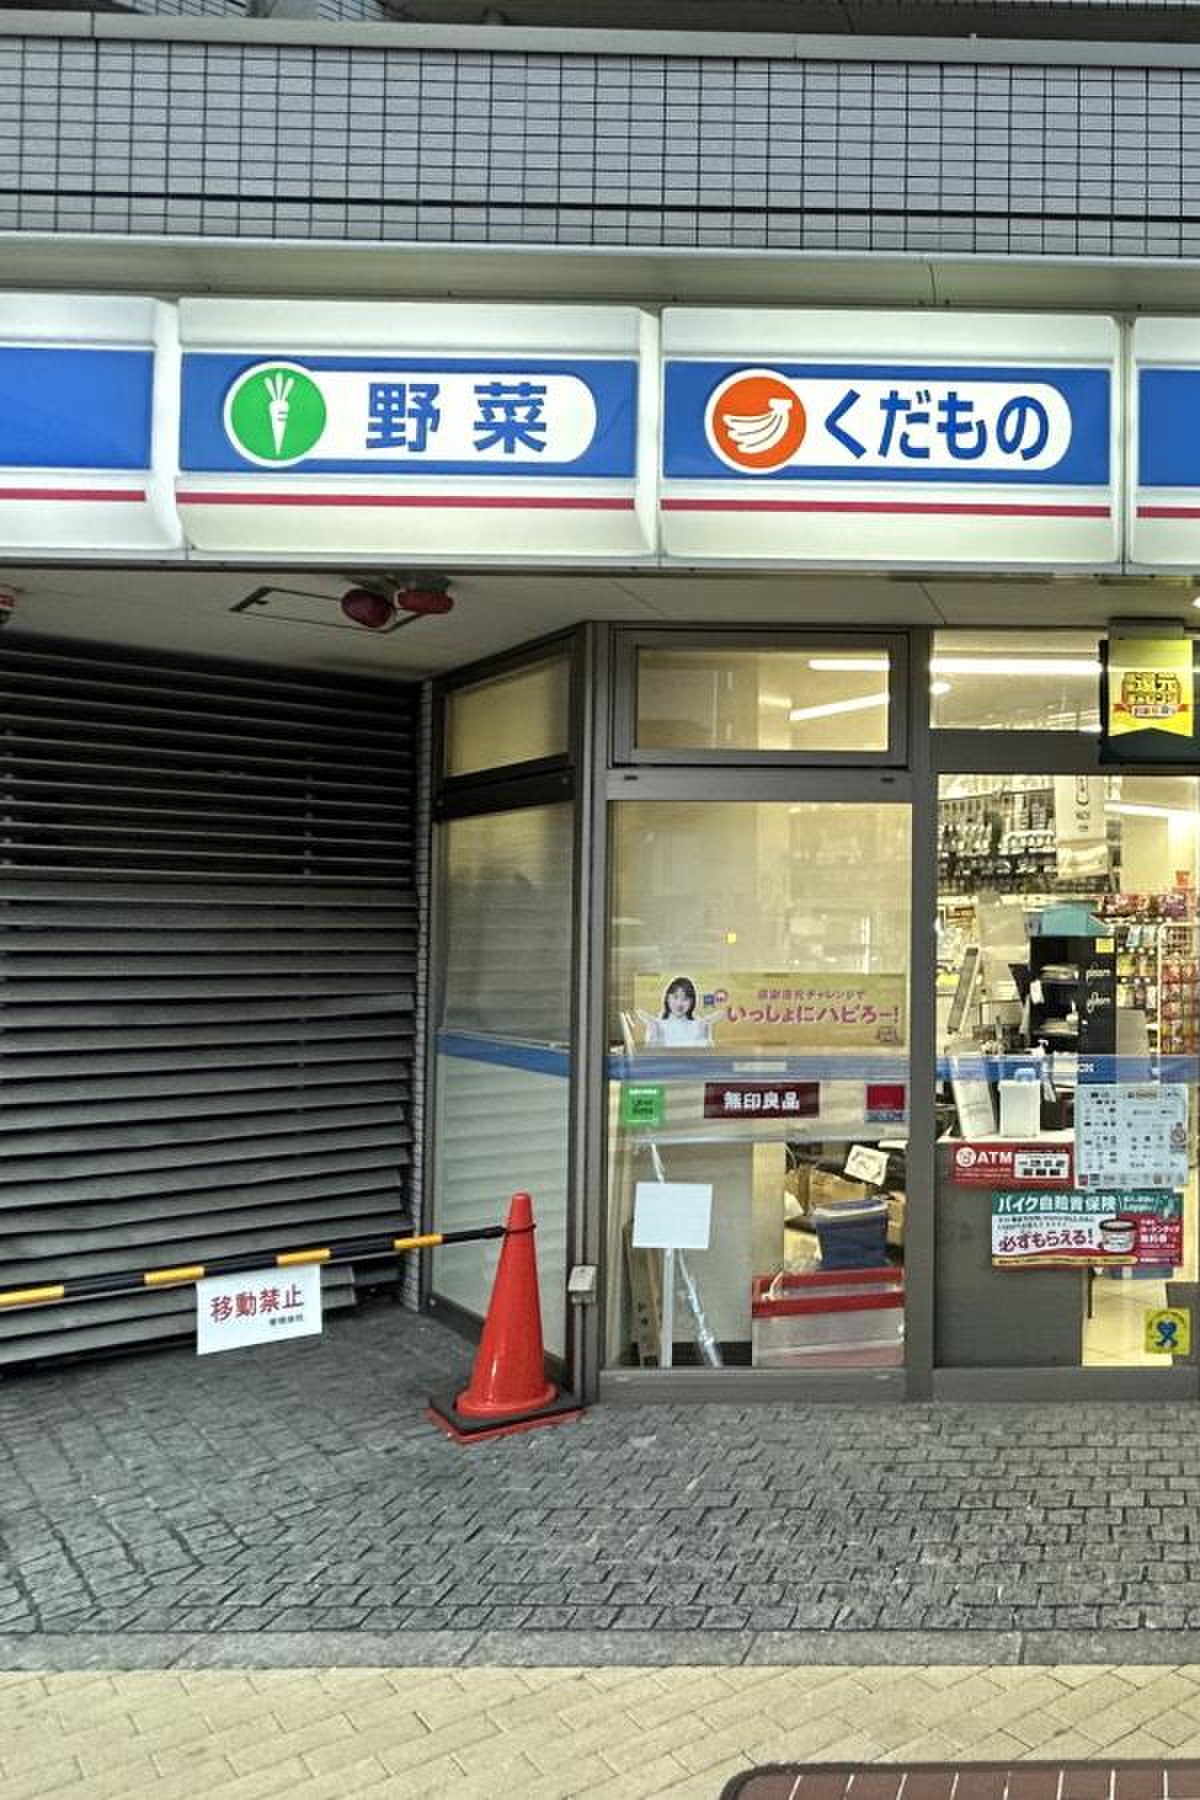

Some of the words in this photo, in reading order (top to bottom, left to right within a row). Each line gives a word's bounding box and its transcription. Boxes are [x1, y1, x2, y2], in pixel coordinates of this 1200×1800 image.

[366, 382, 547, 454] 野菜
[825, 389, 1049, 462] くだもの
[723, 1091, 800, 1111] 無印良品
[977, 1151, 1013, 1164] ATM
[210, 1284, 304, 1324] 移動禁止
